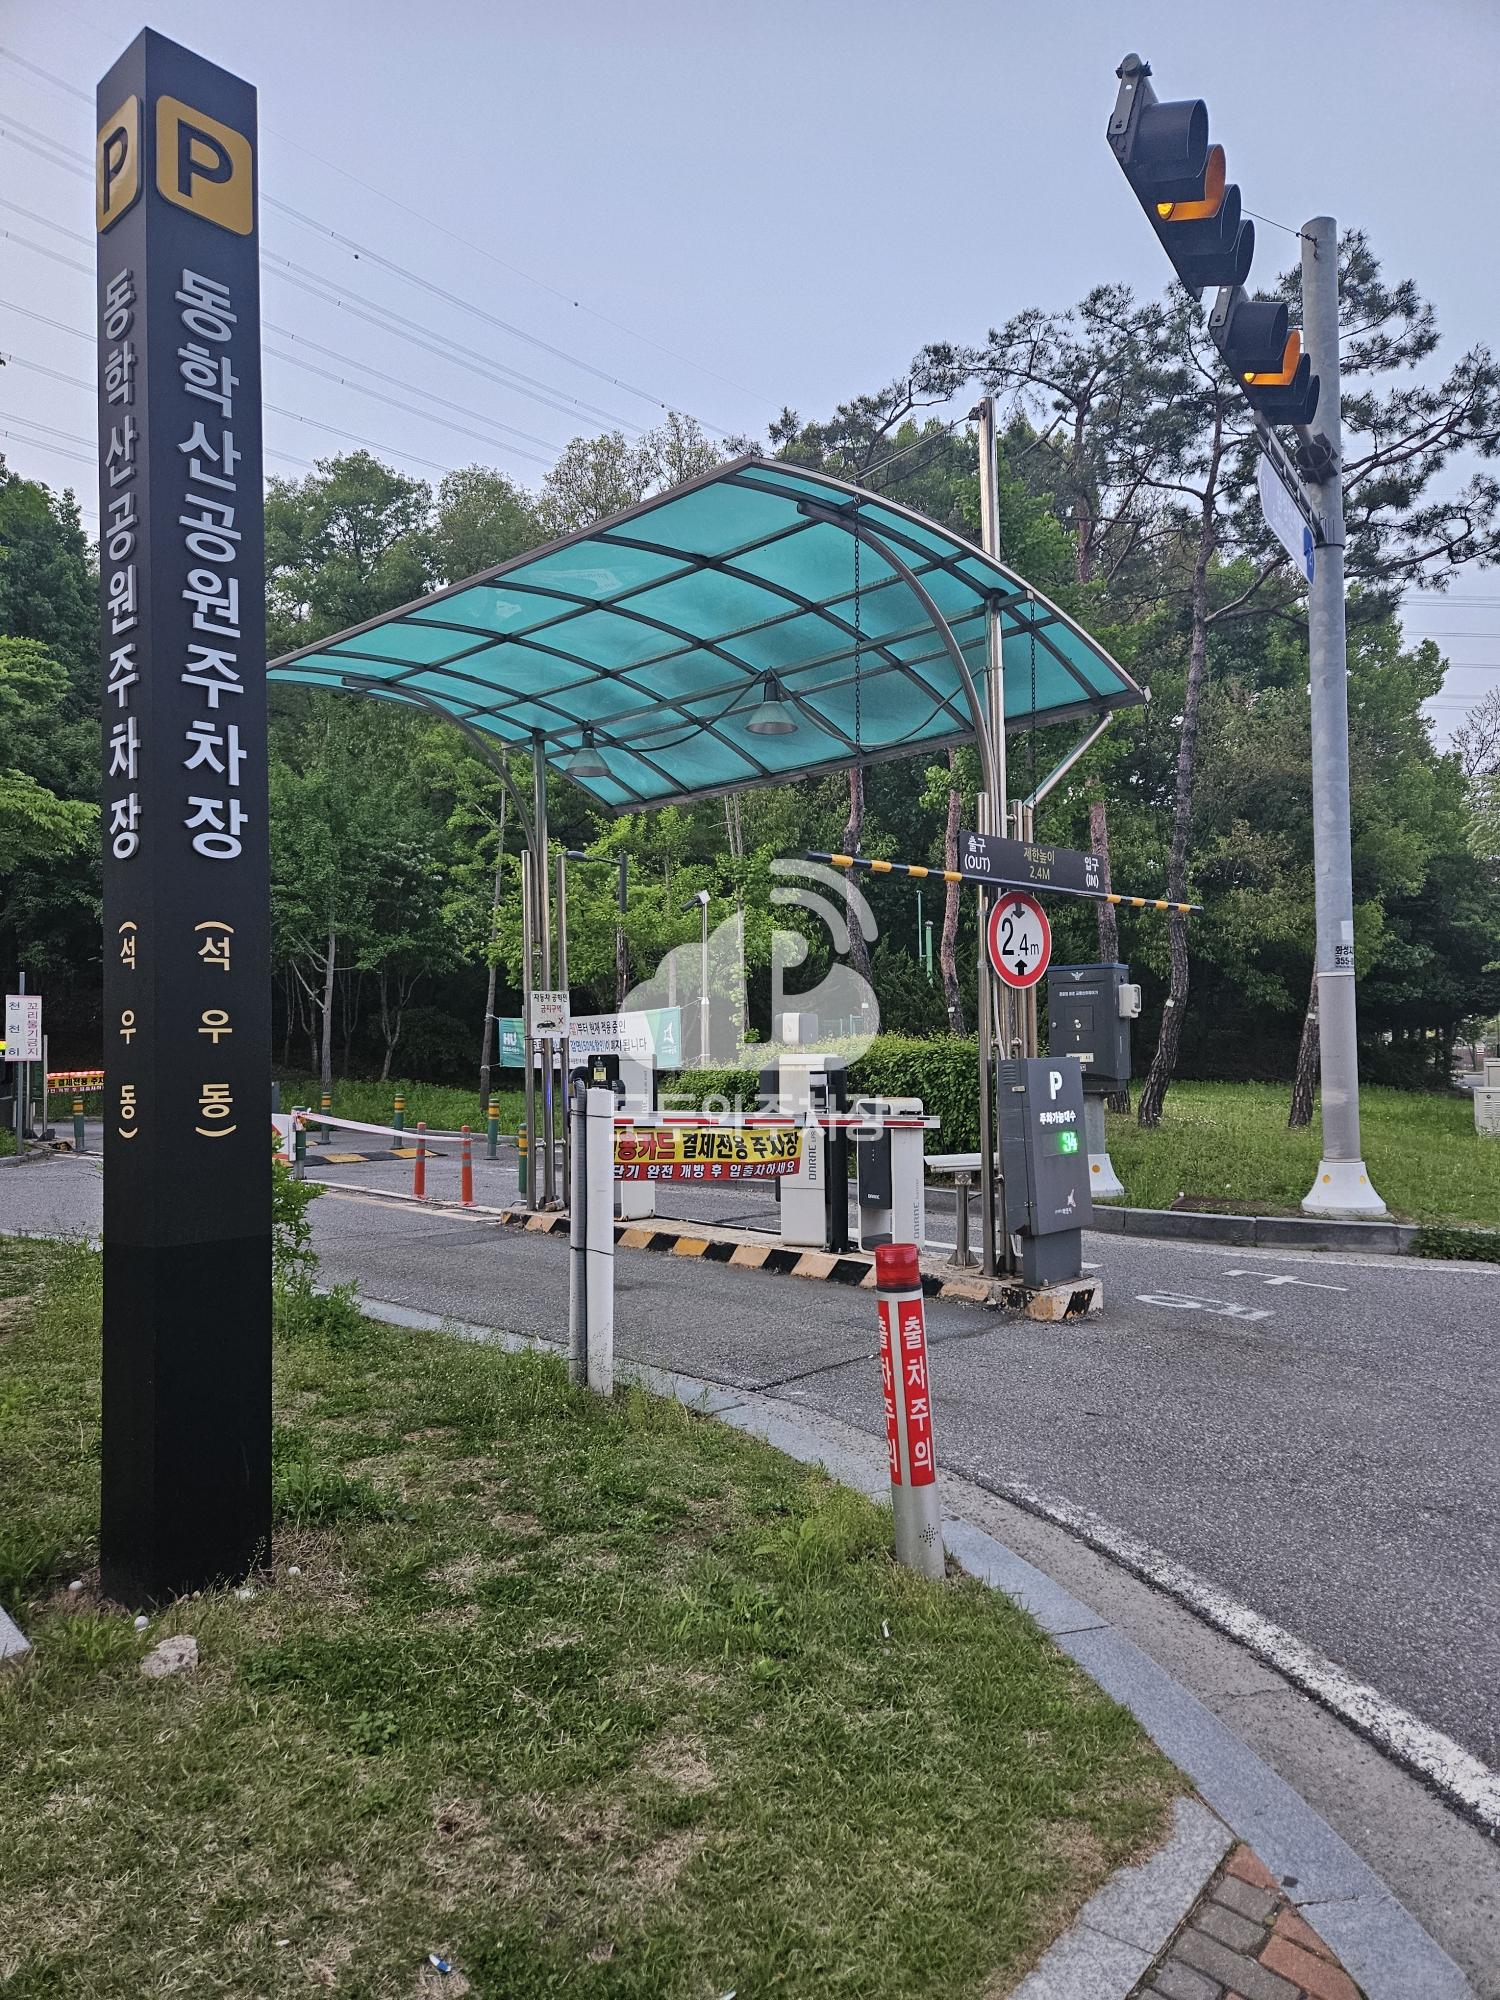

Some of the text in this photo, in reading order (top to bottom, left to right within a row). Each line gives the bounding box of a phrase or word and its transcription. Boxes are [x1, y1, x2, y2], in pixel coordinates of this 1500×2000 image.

[176, 116, 234, 199] P
[102, 126, 129, 213] P
[103, 267, 142, 860] 동학산공원주차장
[174, 267, 249, 1139] 동학산공원주차장 (석우동)
[968, 835, 986, 853] 출구
[964, 853, 991, 872] (OUT)
[1023, 846, 1055, 865] 제한높이
[1084, 856, 1100, 872] 입구
[1029, 865, 1050, 880] 2.4M
[1085, 872, 1099, 889] (IN)
[1001, 917, 1040, 956] 2.4m
[1049, 1071, 1063, 1100] P
[1039, 1110, 1077, 1126] 주차가능대수
[614, 1130, 676, 1161] 용카드
[682, 1131, 748, 1160] 결제전용
[1062, 1131, 1078, 1152] 34
[647, 1164, 674, 1179] 완전
[680, 1163, 705, 1178] 개방
[711, 1163, 722, 1178] 후
[729, 1160, 795, 1178] 입출차하세요
[903, 1316, 932, 1472] 출차주의
